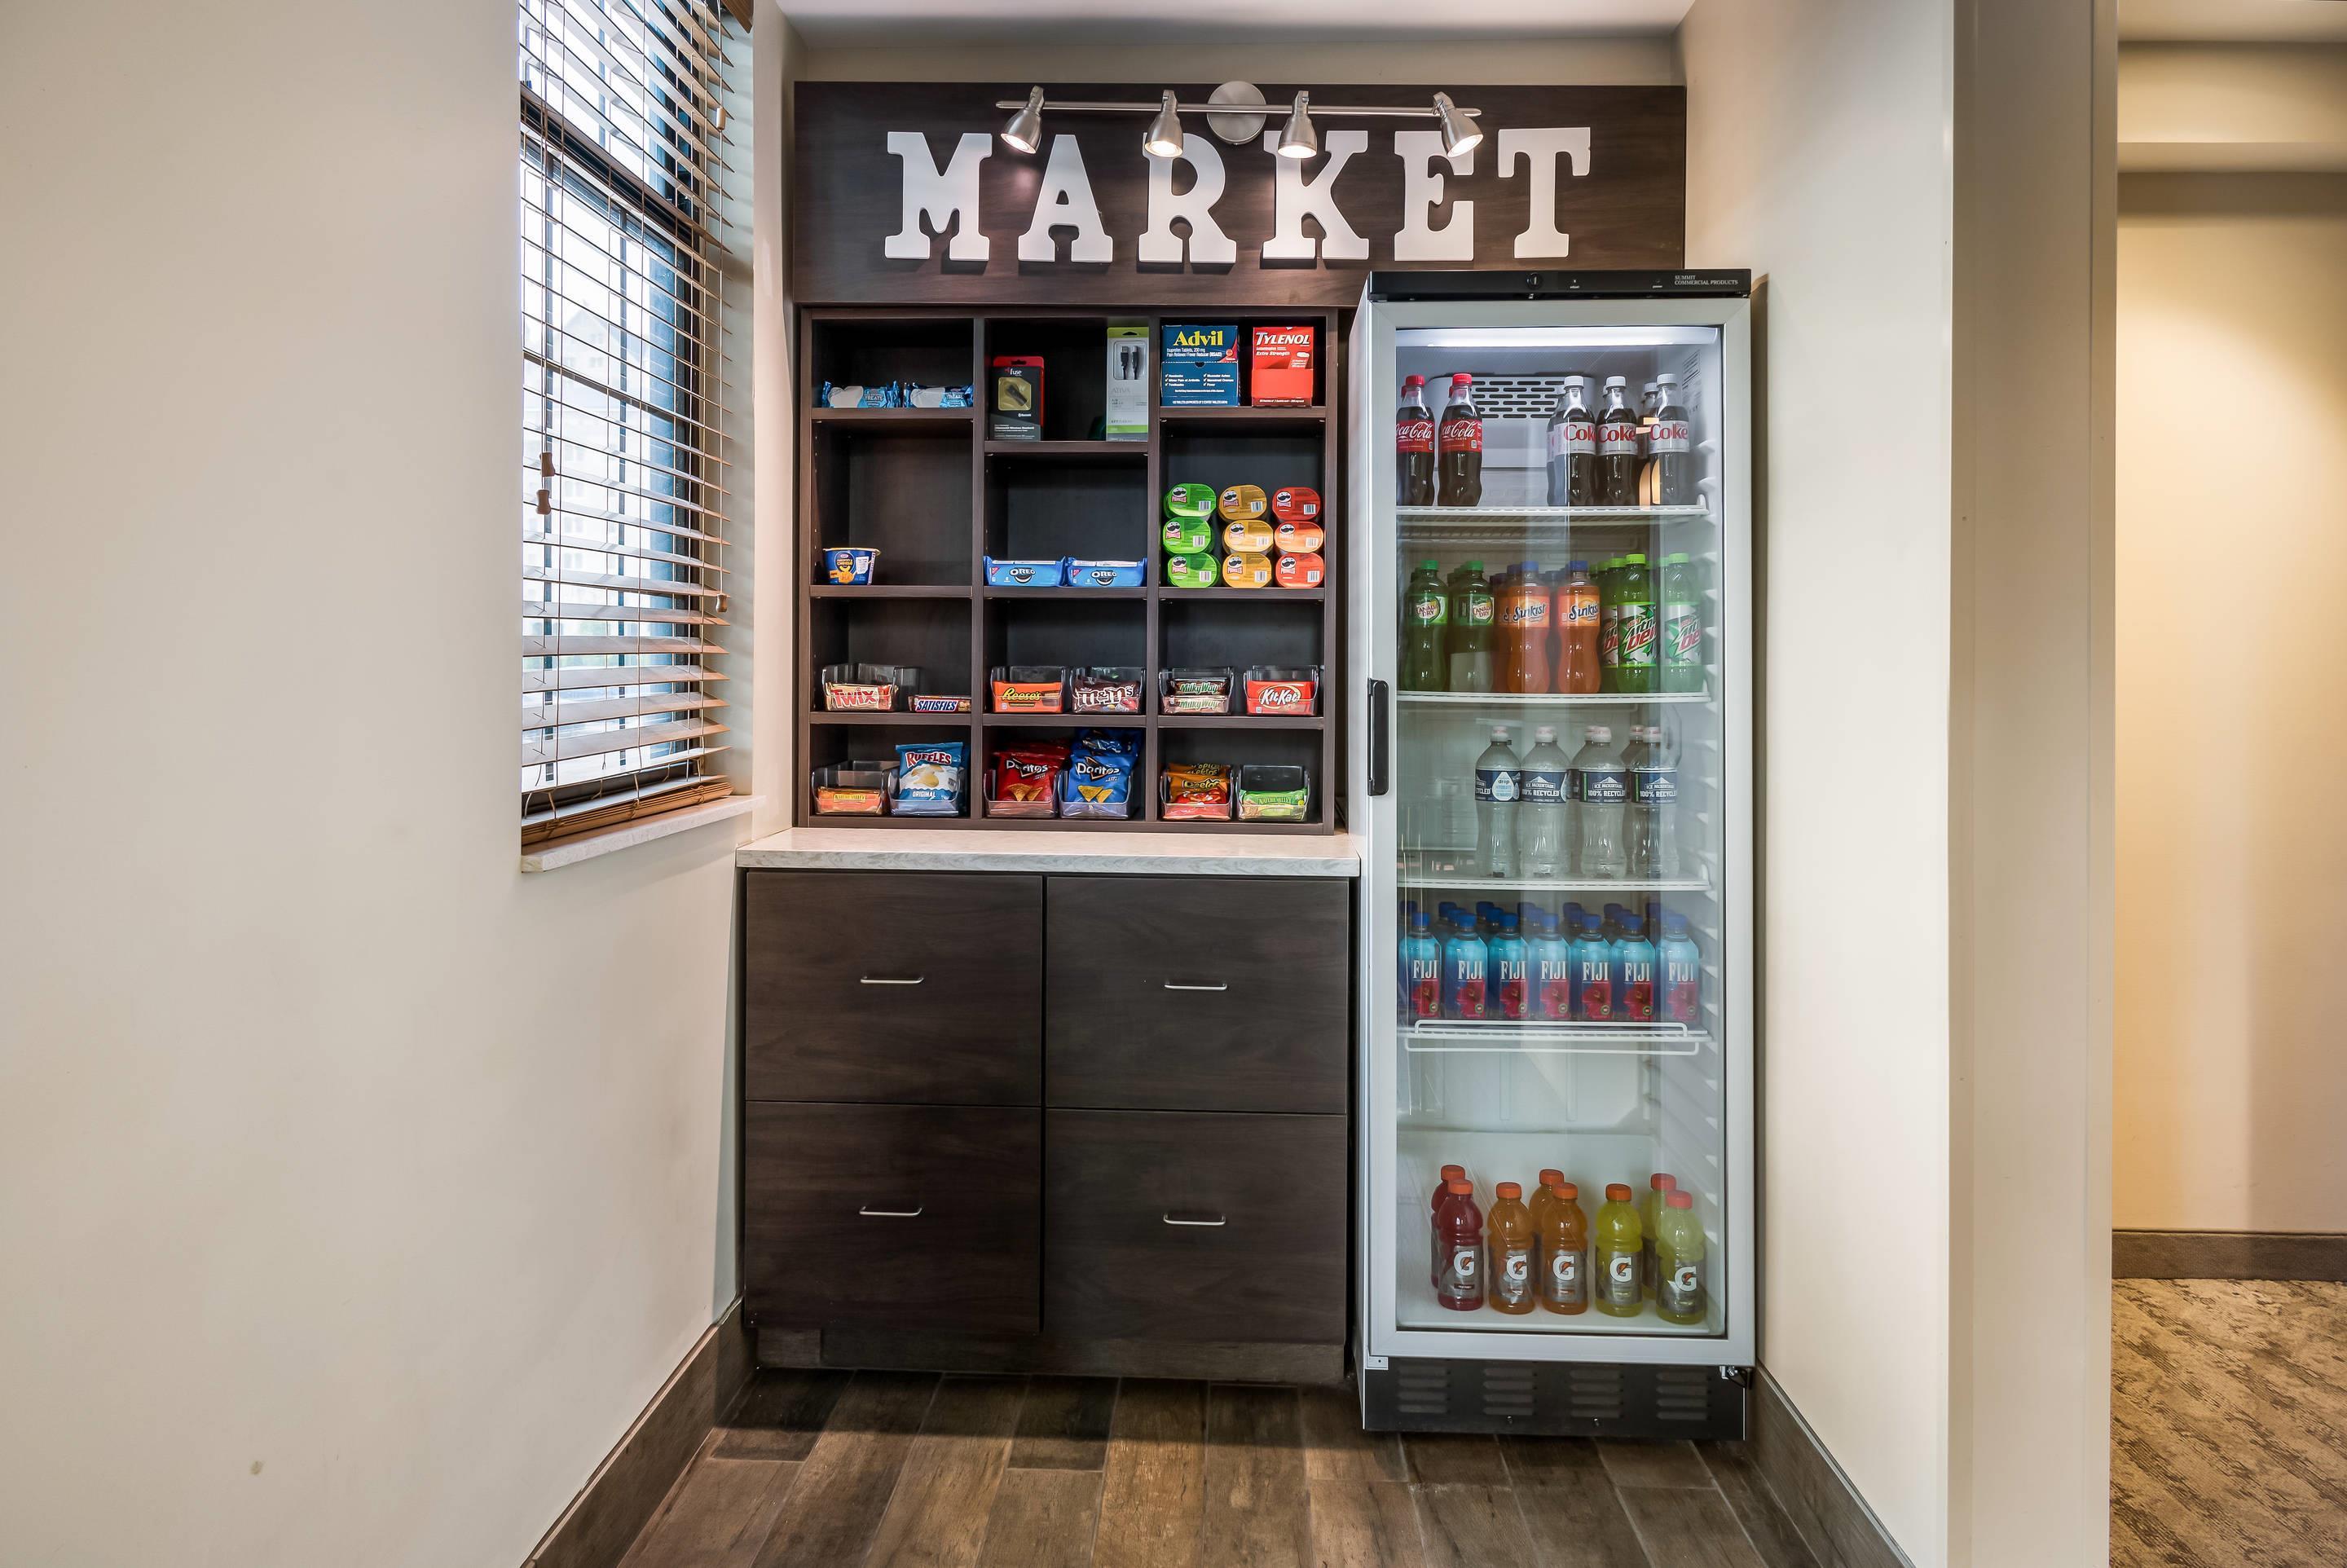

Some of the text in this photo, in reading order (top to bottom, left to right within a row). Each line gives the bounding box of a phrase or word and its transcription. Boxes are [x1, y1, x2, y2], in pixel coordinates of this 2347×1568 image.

[883, 126, 1591, 263] MARKET
[1173, 330, 1223, 346] Advil
[1256, 332, 1310, 346] TYLENOL
[1598, 425, 1636, 443] Coke
[1650, 424, 1689, 441] Coke
[1009, 568, 1036, 576] OREO
[1090, 570, 1117, 578] OREO
[1513, 603, 1546, 622] Sunkist
[1569, 603, 1598, 620] Sunkis
[917, 700, 957, 711] SATISFIES
[905, 751, 952, 767] RUFFLES
[1006, 760, 1049, 773] Doritos
[1077, 762, 1120, 774] Doritos
[1413, 960, 1438, 979] FIJI
[1458, 960, 1482, 979] FIJI
[1500, 961, 1526, 980] FIJI
[1541, 961, 1566, 980] FIJI
[1583, 962, 1609, 980] FIJI
[1625, 962, 1650, 982] FIJI
[1668, 962, 1693, 981] FIJI
[1454, 1251, 1474, 1275] G
[1507, 1254, 1527, 1280] G
[1552, 1255, 1574, 1280] G
[1609, 1257, 1631, 1282] G
[1674, 1266, 1697, 1292] G
